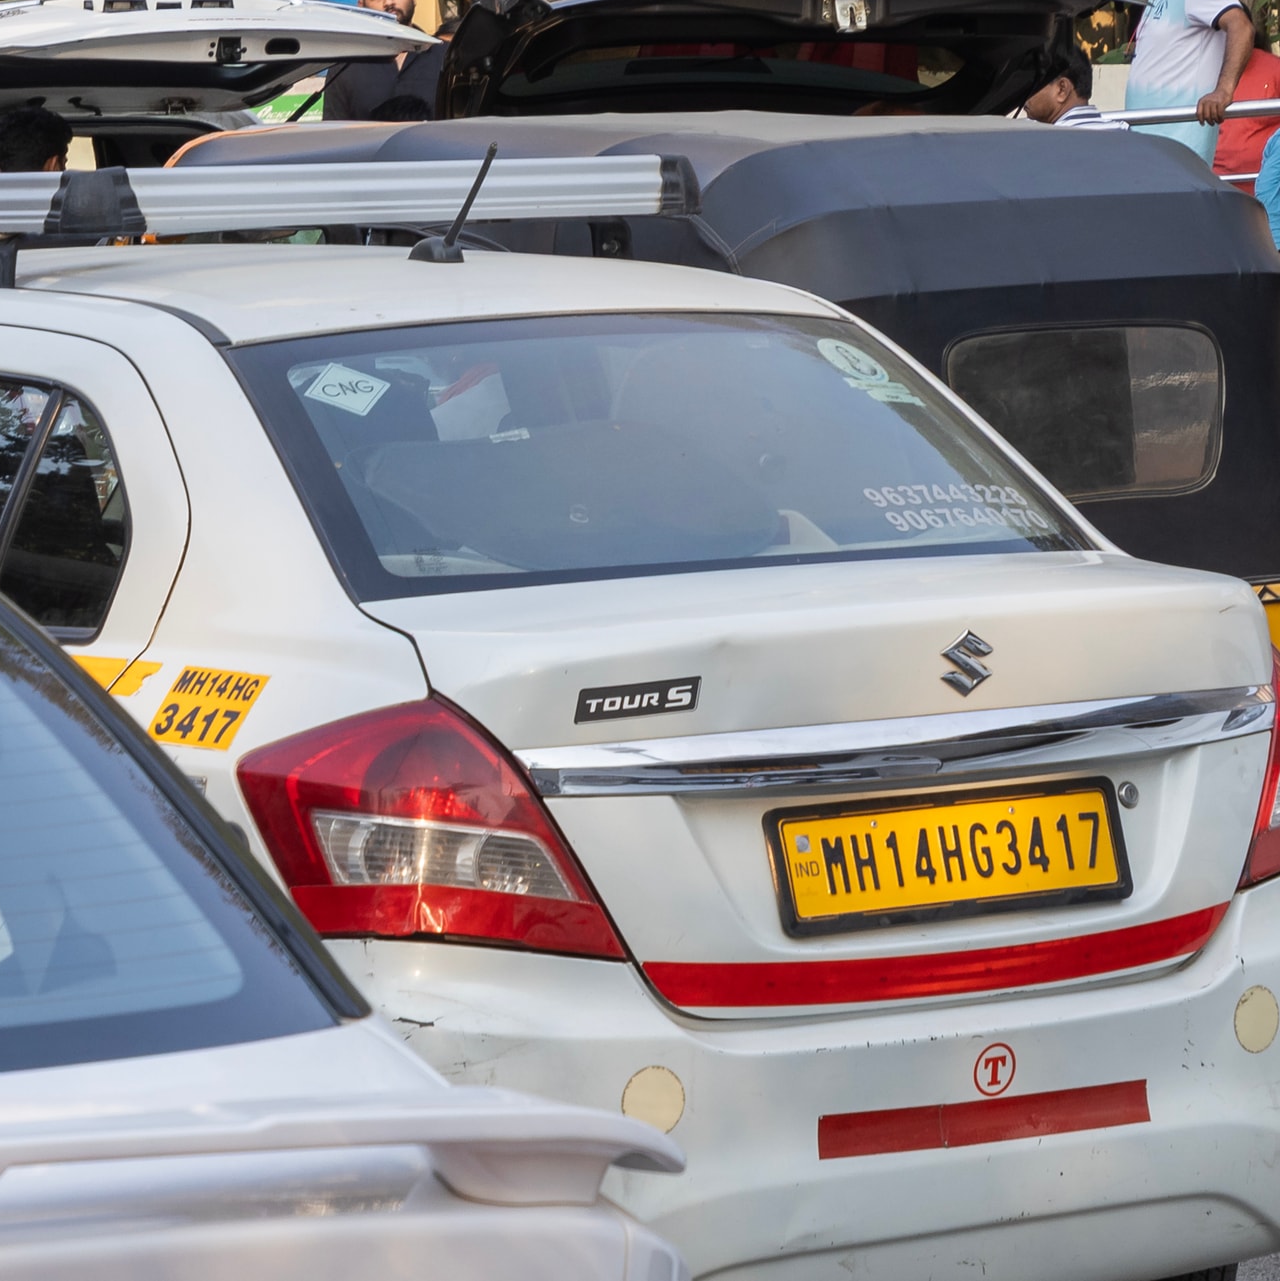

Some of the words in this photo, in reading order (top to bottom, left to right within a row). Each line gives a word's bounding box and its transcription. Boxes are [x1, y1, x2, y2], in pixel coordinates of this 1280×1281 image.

[322, 380, 374, 397] CNG
[863, 484, 1028, 508] 9637443228
[885, 507, 1049, 532] 9067640170
[172, 669, 260, 701] MH14HG
[585, 692, 660, 713] TOUR
[664, 685, 693, 708] S
[154, 703, 242, 744] 3417
[820, 811, 1100, 895] MH14HG3417
[795, 861, 820, 879] IND
